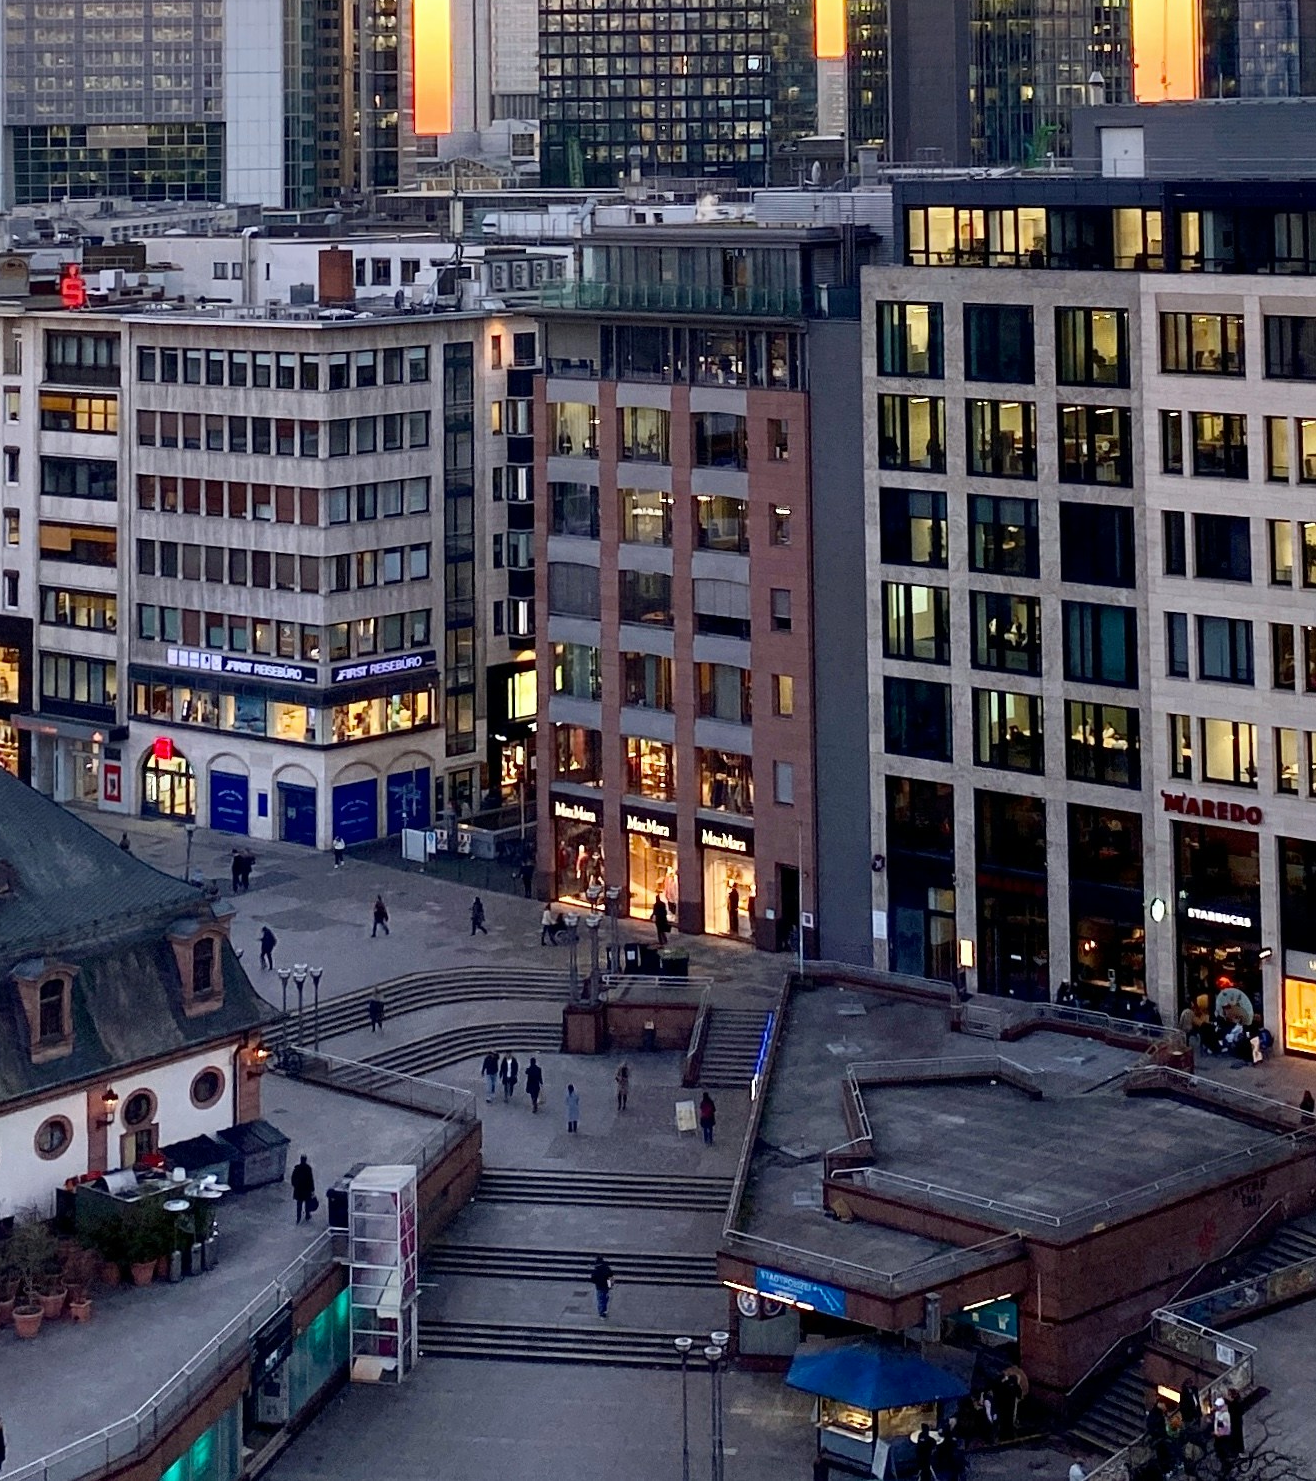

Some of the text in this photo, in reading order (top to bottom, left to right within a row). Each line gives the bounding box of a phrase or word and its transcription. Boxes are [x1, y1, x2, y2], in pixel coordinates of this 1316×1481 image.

[254, 663, 302, 681] REISEBÜRO
[370, 655, 423, 676] REISEBÜRO
[555, 801, 596, 822] MaxMara
[1160, 789, 1263, 826] MAREDO
[626, 814, 670, 837] MaxMara
[701, 828, 747, 852] MaxMara
[1187, 907, 1252, 928] STARBUCKS
